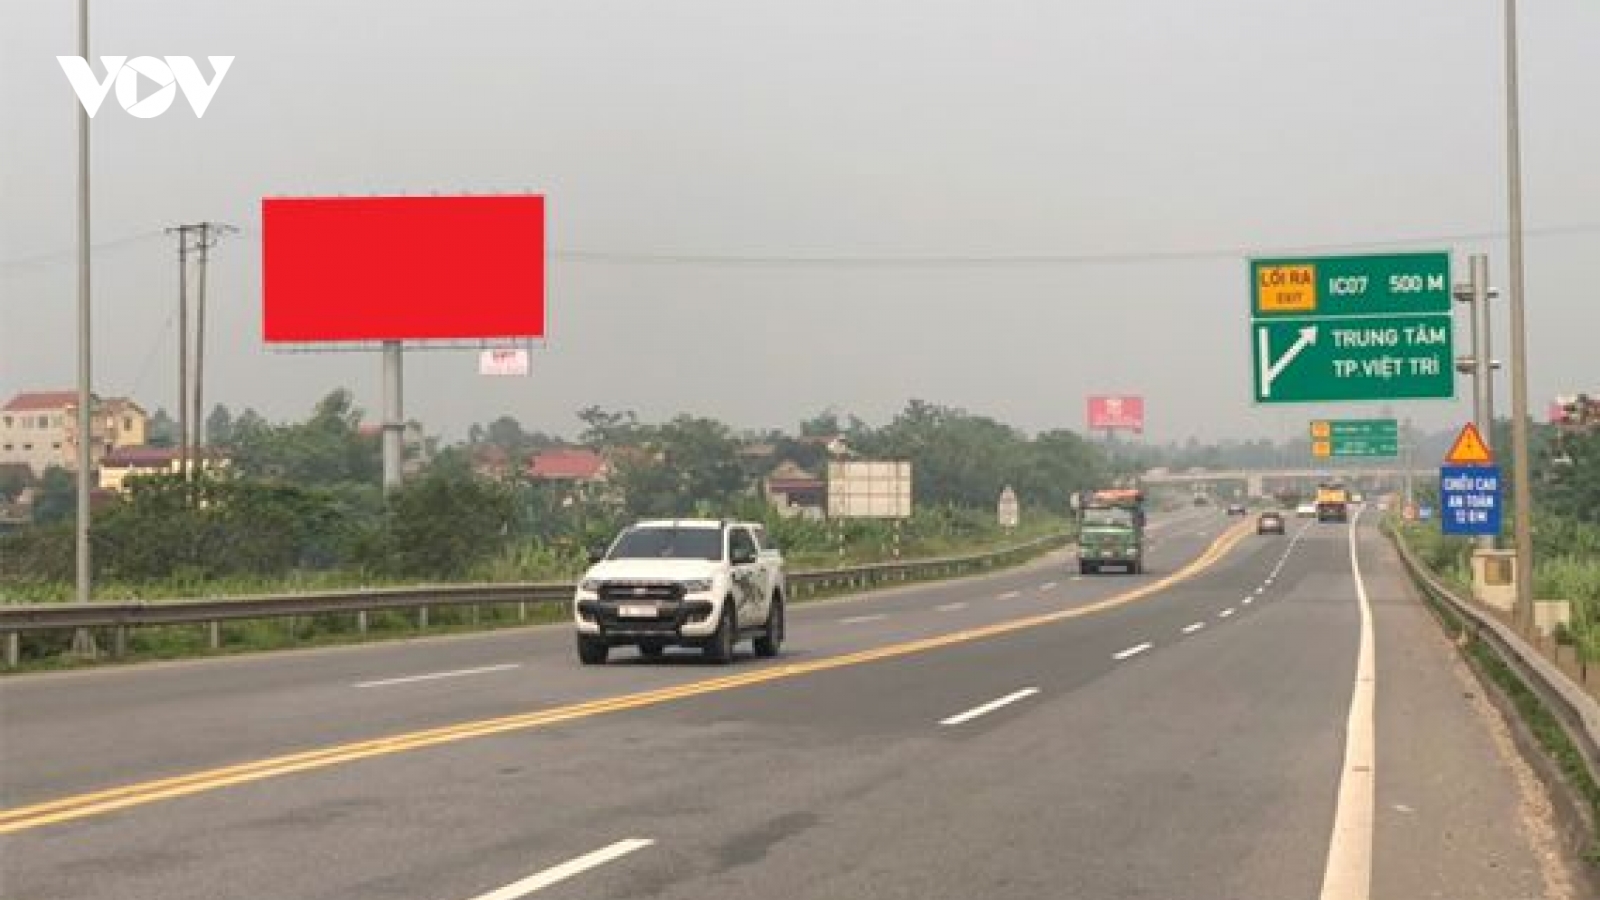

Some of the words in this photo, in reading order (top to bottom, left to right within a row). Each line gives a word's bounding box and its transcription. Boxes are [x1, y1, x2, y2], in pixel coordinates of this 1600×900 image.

[1290, 269, 1311, 285] RA
[1329, 275, 1368, 295] IC07
[1389, 273, 1423, 293] 500
[1428, 273, 1444, 291] M
[1331, 328, 1398, 347] TRUNG
[1403, 323, 1446, 344] TÂM
